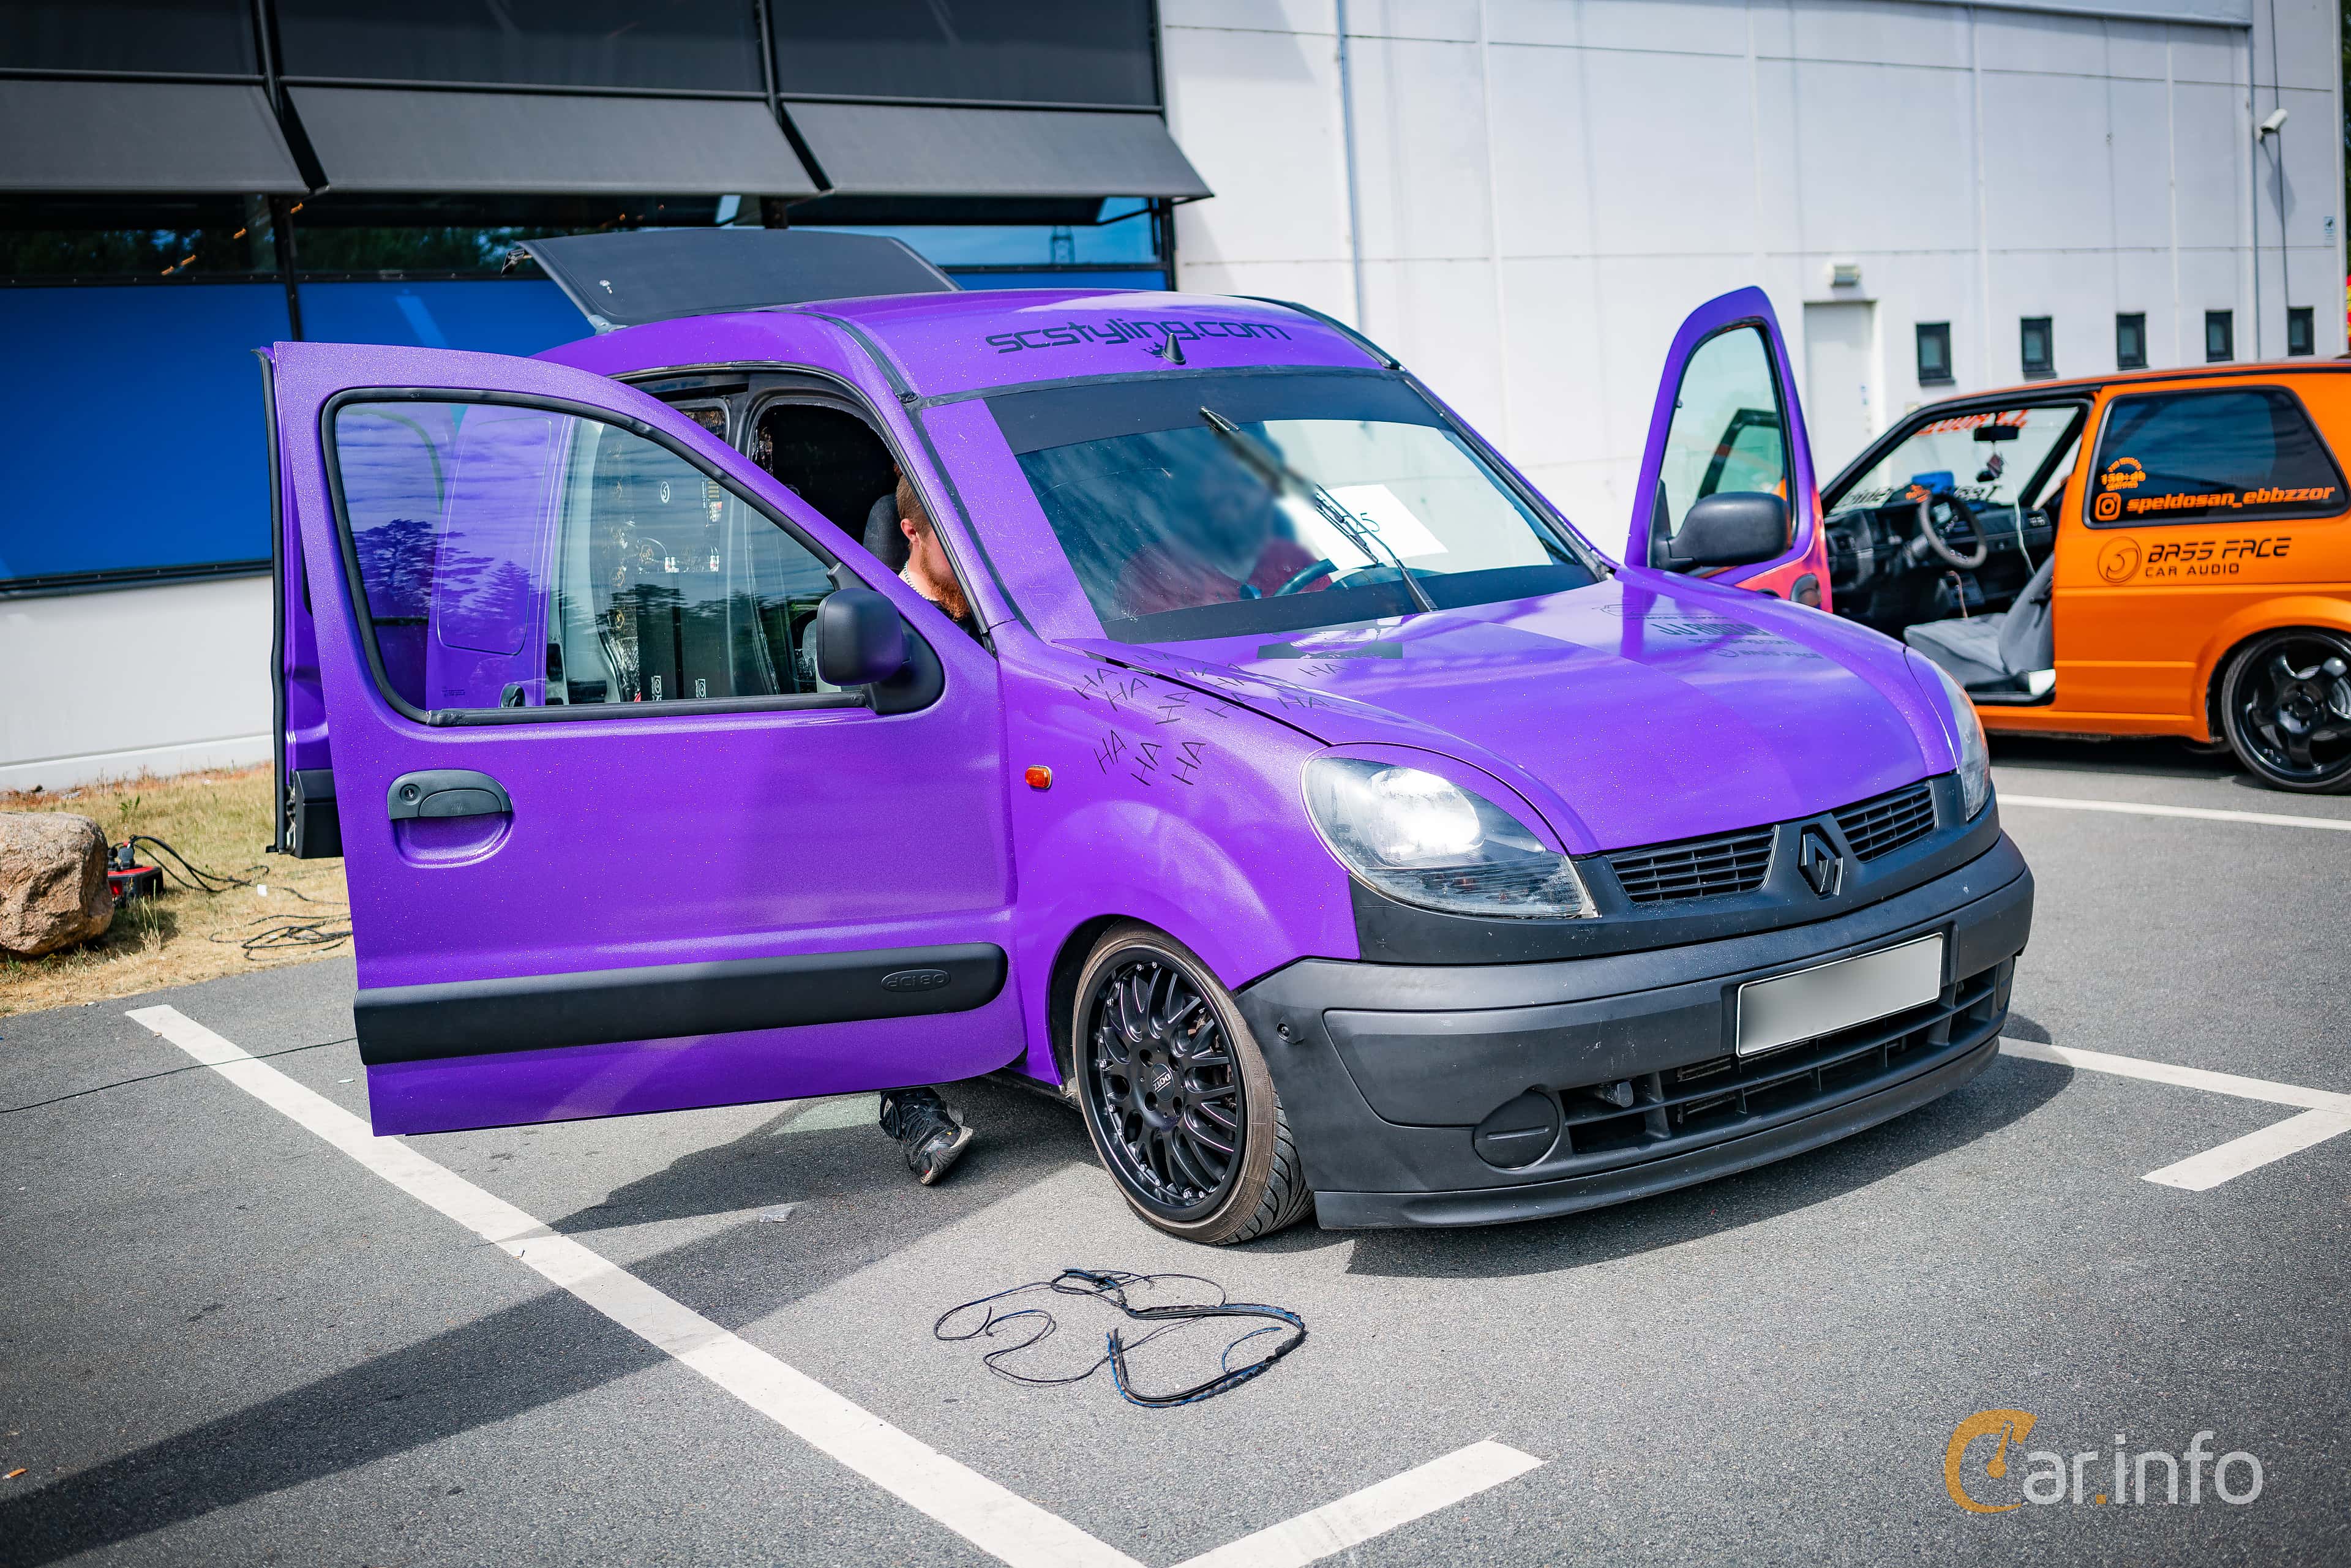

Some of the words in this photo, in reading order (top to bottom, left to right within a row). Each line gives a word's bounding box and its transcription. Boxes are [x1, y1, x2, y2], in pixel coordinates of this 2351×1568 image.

[986, 318, 1292, 353] scstyling.com
[2126, 486, 2335, 514] speldosan_ebbzzor
[2148, 540, 2216, 563] BASS
[2222, 537, 2292, 559] FACE
[2145, 565, 2177, 578] CAR
[2187, 563, 2239, 576] AUDIO
[1073, 668, 1117, 700] HA
[1298, 664, 1349, 677] HA
[1106, 678, 1149, 711] HA
[1155, 692, 1195, 726] HA
[1278, 696, 1330, 710] HA
[1093, 729, 1127, 775] HA
[1131, 742, 1162, 786] HA
[1172, 741, 1206, 785] HA
[1153, 1073, 1171, 1091] DOTZ
